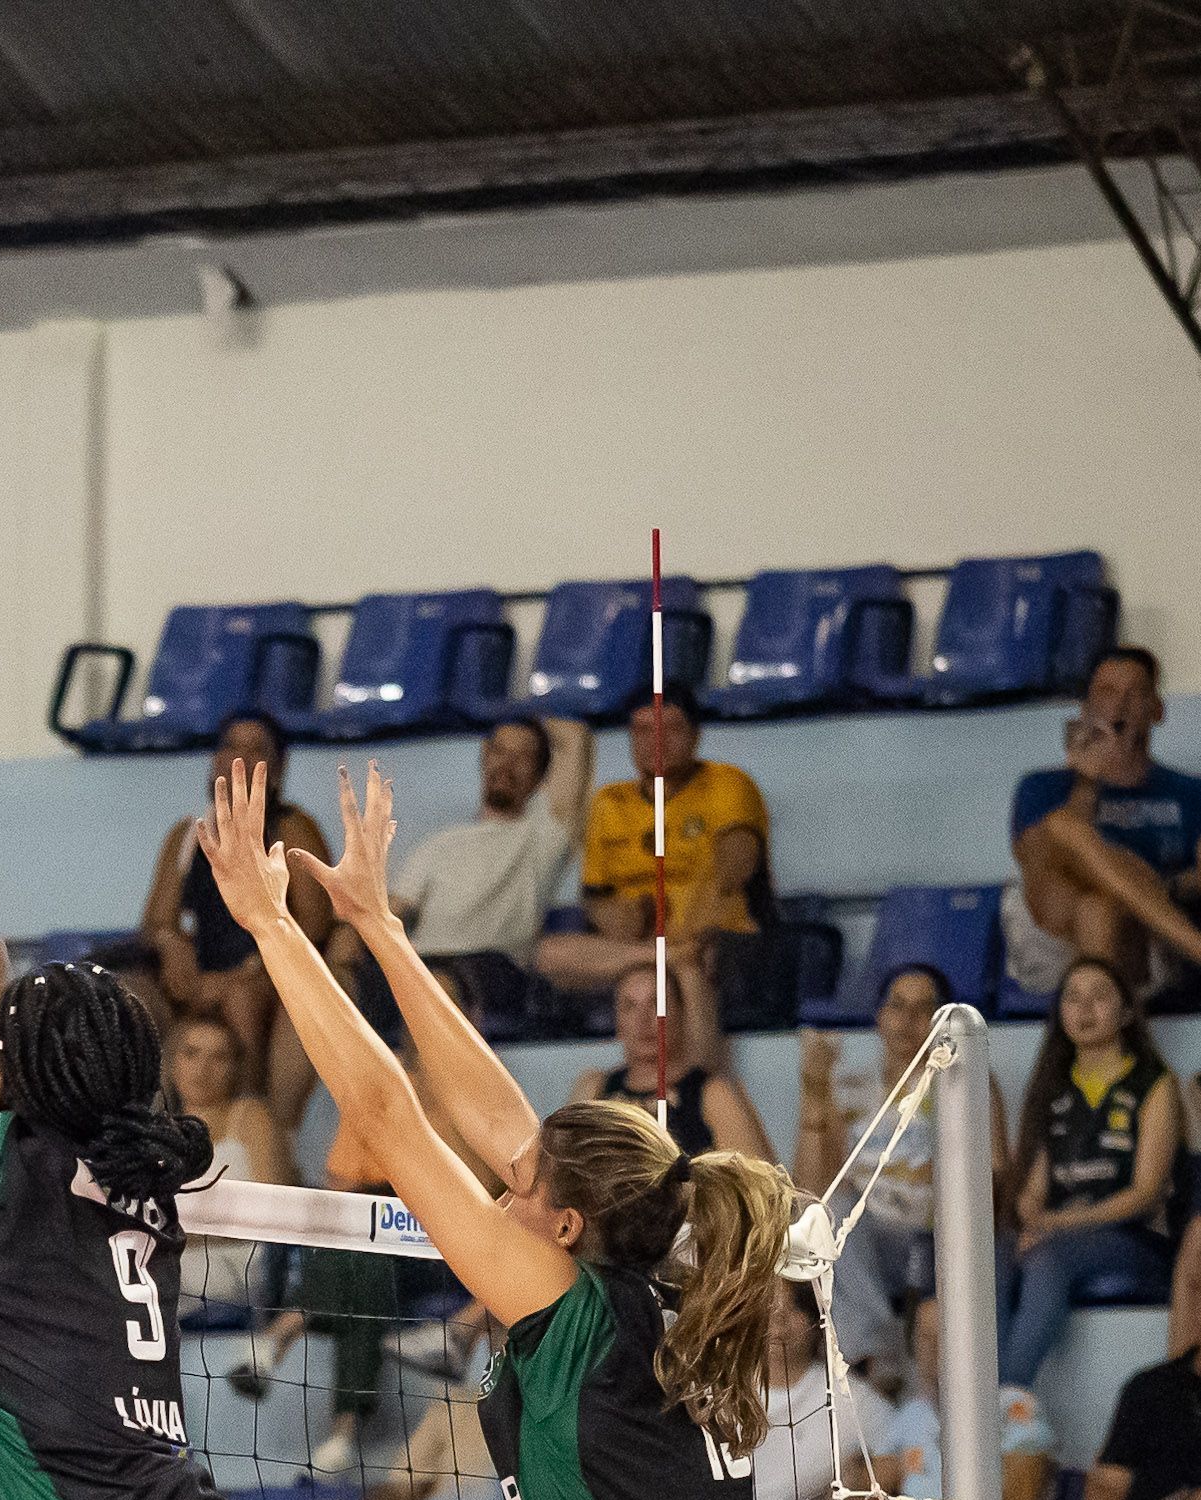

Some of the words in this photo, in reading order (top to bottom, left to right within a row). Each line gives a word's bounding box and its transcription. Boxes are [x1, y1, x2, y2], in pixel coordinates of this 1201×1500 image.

[380, 1202, 426, 1233] Den
[108, 1230, 167, 1362] 9
[114, 1386, 188, 1444] LÍVIA
